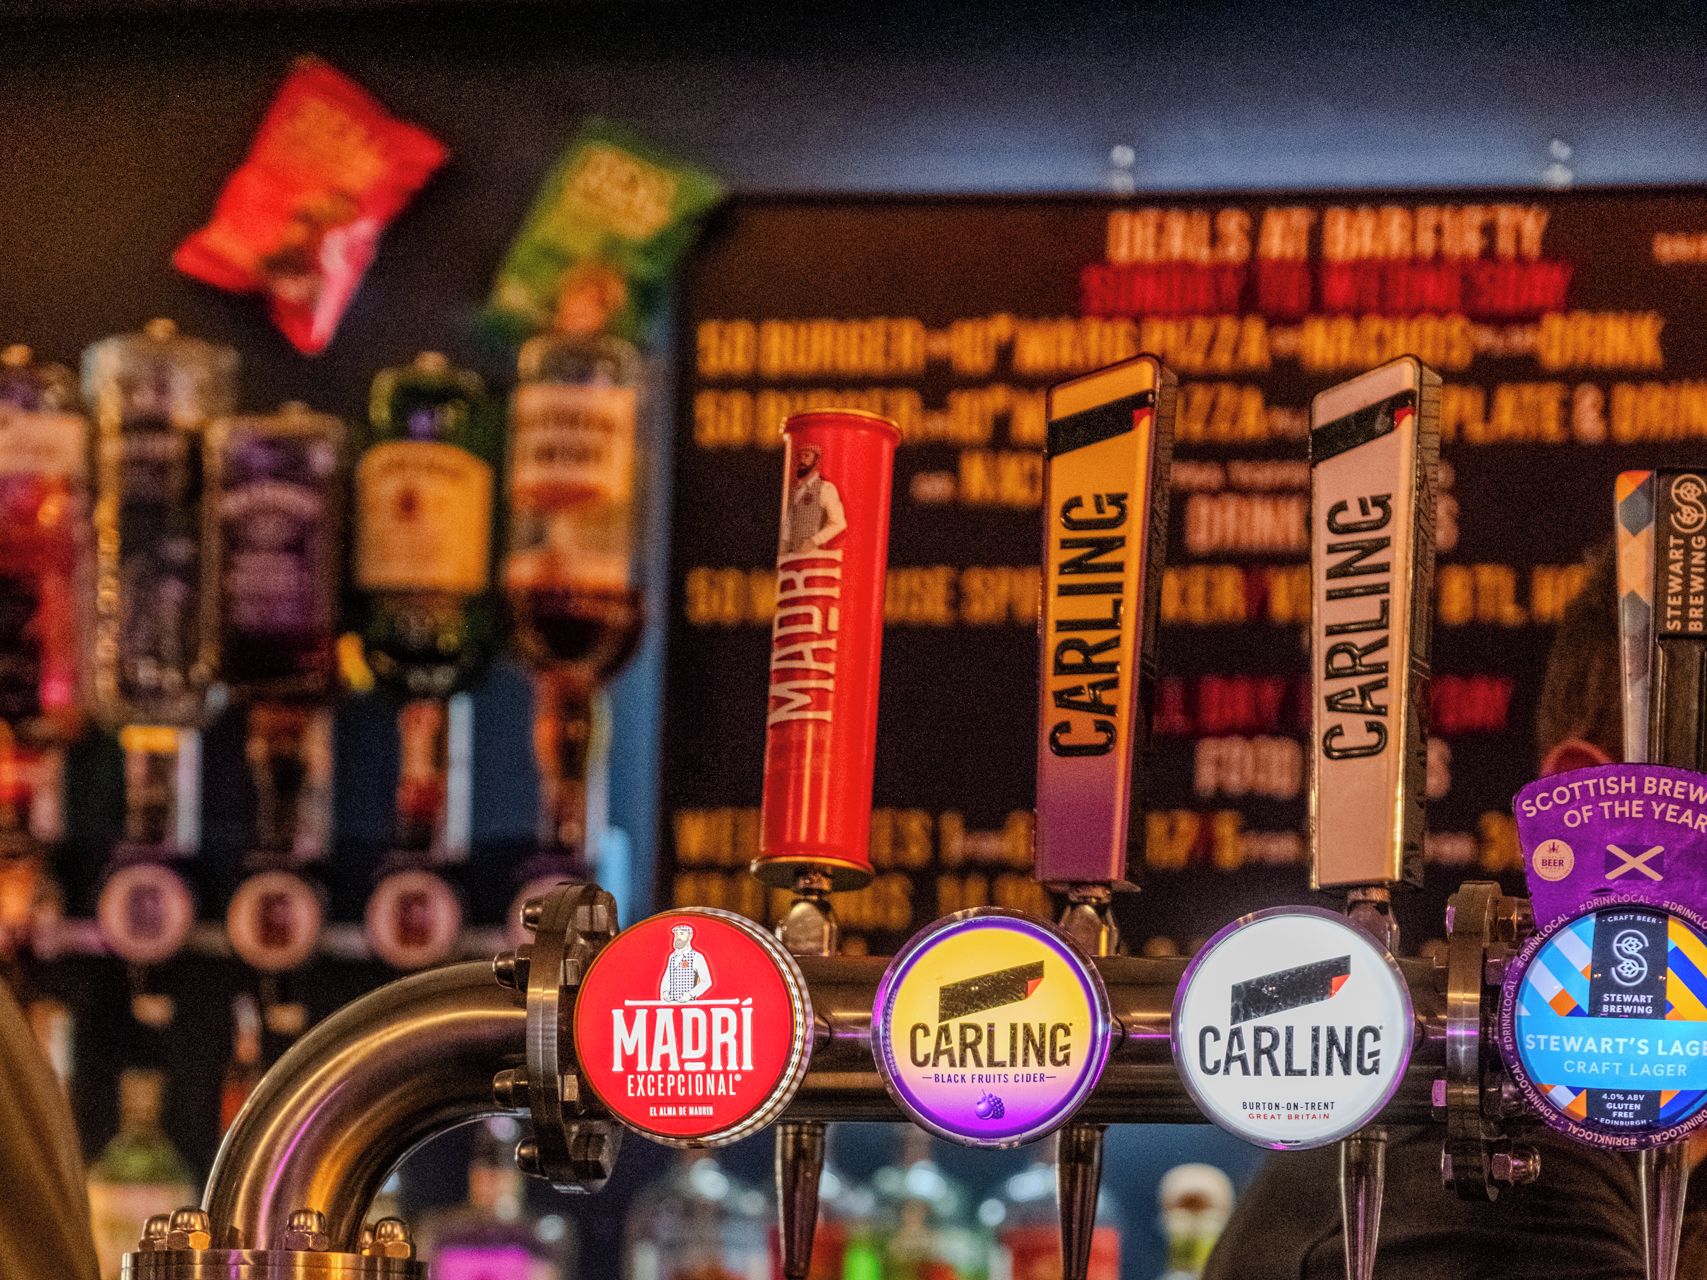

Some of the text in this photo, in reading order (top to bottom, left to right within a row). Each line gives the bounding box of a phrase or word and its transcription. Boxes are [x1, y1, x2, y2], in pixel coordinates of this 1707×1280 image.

[1666, 535, 1685, 631] STEWART
[1688, 535, 1706, 632] BREWING
[1049, 492, 1129, 758] CARLING
[1322, 493, 1393, 761] CARLING
[1521, 776, 1636, 818] SCOTTISH
[1563, 800, 1707, 834] OF THE YEAR
[1541, 858, 1564, 867] BEER
[1579, 894, 1650, 912] #DRINKLOCAL
[1607, 914, 1657, 924] CRAFT BEER
[1517, 912, 1570, 968] #DRINKLOCAL
[1603, 993, 1653, 1003] STEWART
[1502, 979, 1518, 1051] #DRINKLOCAL
[1602, 1004, 1653, 1014] BREWING
[909, 1022, 1071, 1068] CARLING
[1199, 1025, 1381, 1077] CARLING
[1563, 1060, 1688, 1077] CRAFT LAGER
[934, 1073, 1046, 1084] BLACK FRUITS CIDER
[1602, 1093, 1625, 1101] 4.0%
[650, 1106, 714, 1117] EL ALMA DE MADRID
[1242, 1101, 1336, 1111] BURTON-ON-TRENT
[1606, 1102, 1641, 1110] GLUTEN
[1248, 1112, 1330, 1120] GREAT BRITAIN
[1600, 1117, 1647, 1126] EDINBURGH
